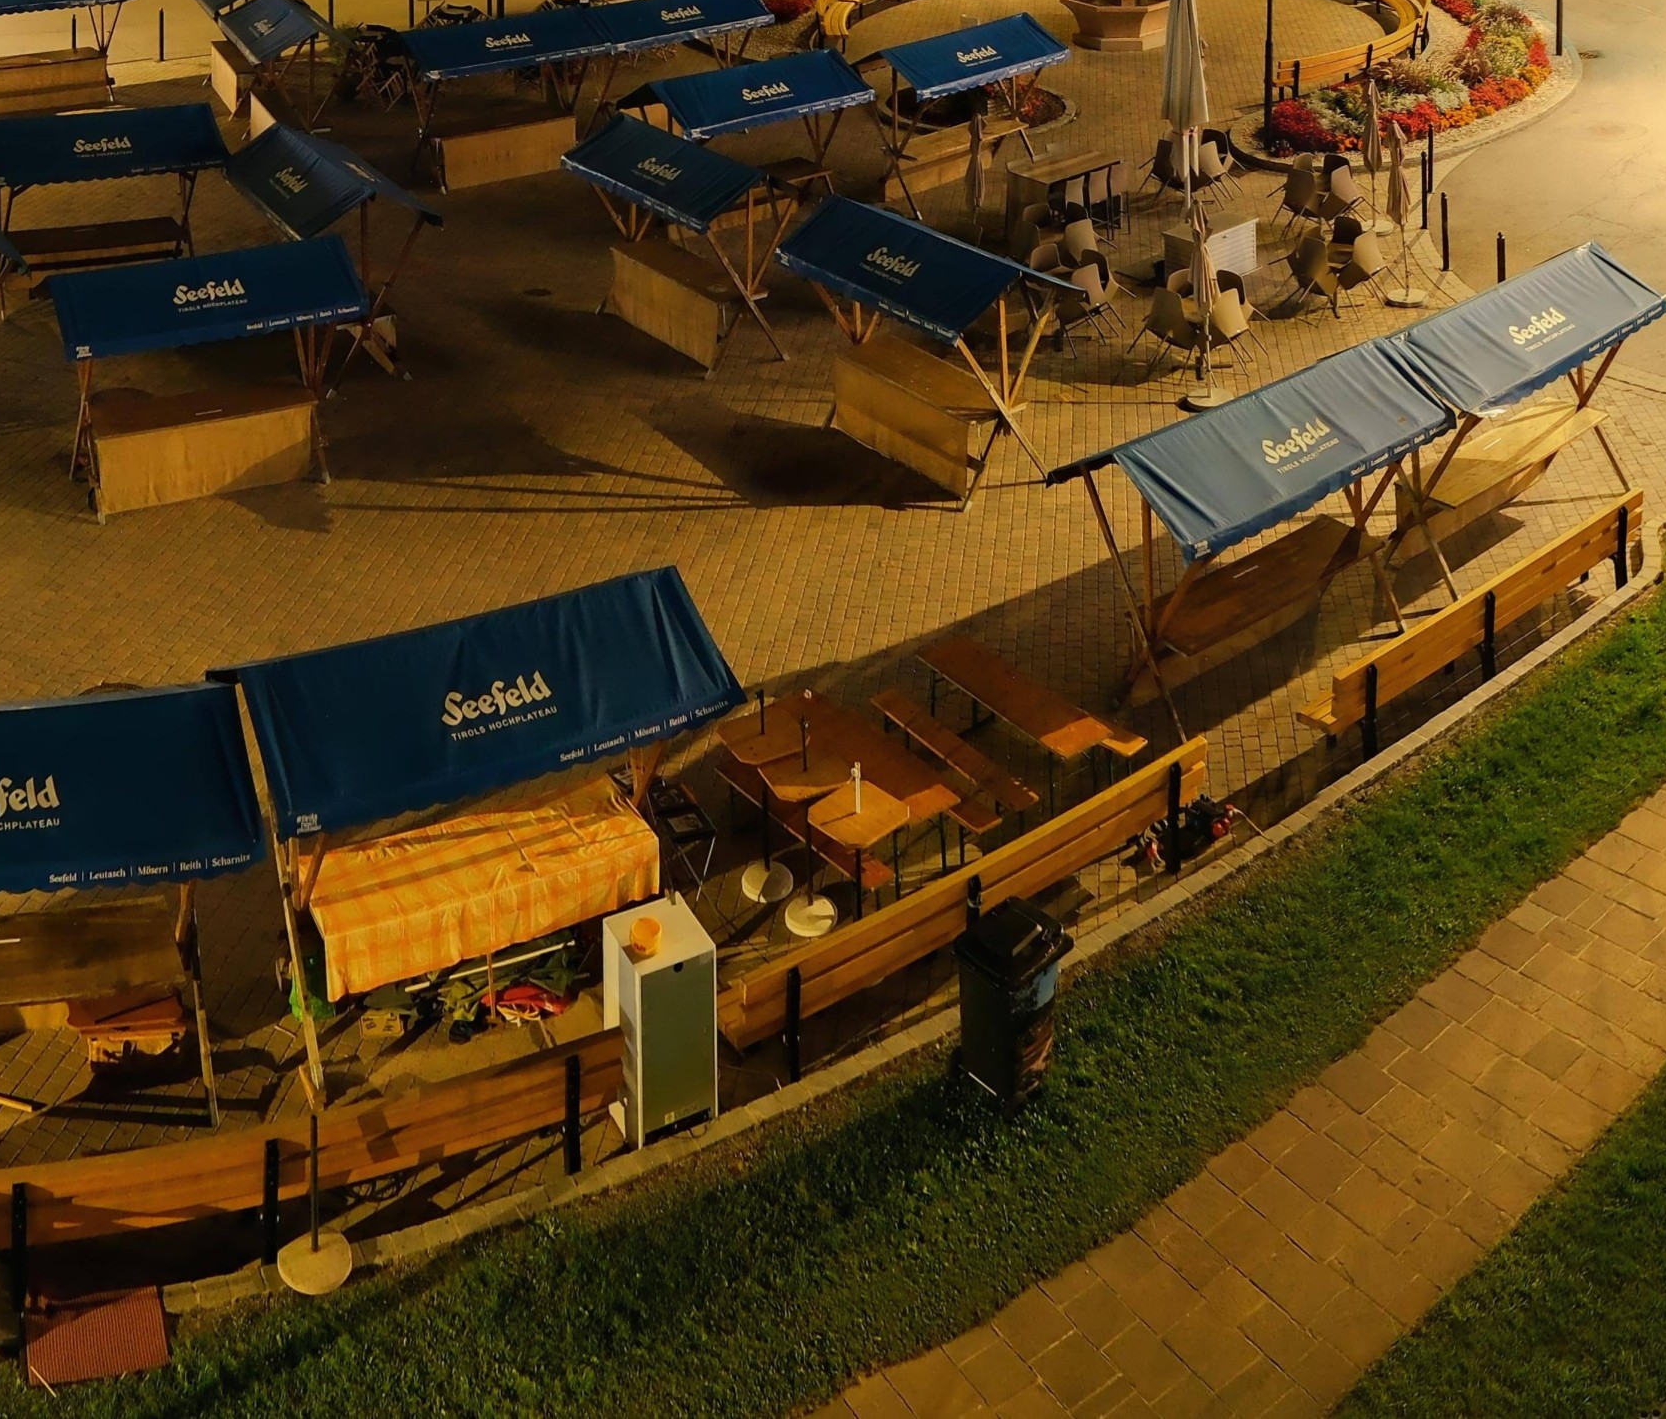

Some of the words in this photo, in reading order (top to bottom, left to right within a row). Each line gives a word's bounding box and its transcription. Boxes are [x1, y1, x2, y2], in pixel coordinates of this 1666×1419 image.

[661, 5, 702, 21] Seefeld
[485, 33, 531, 48] Seefeld
[957, 45, 998, 64] Seefeld
[742, 81, 790, 101] Seefeld
[72, 135, 132, 153] Seefeld
[637, 156, 684, 181] Seefeld
[866, 246, 922, 278] Seefeld
[172, 277, 246, 305] Seefeld
[1508, 306, 1567, 346] Seefeld
[1261, 417, 1331, 464] Seefeld
[441, 669, 553, 726] Seefeld
[451, 725, 486, 741] TIROLS
[488, 705, 558, 731] HOCHPLATEAU
[559, 747, 585, 762] Seefeld
[593, 735, 626, 753] Leutasch
[634, 724, 662, 740] Mösern
[669, 714, 688, 728] Reith
[695, 699, 730, 719] Scharnitz
[49, 871, 78, 884] Seefeld
[89, 867, 126, 881] Leutasch
[137, 864, 169, 877] Mösern
[179, 860, 202, 872] Reith
[211, 853, 251, 868] Scharnitz
